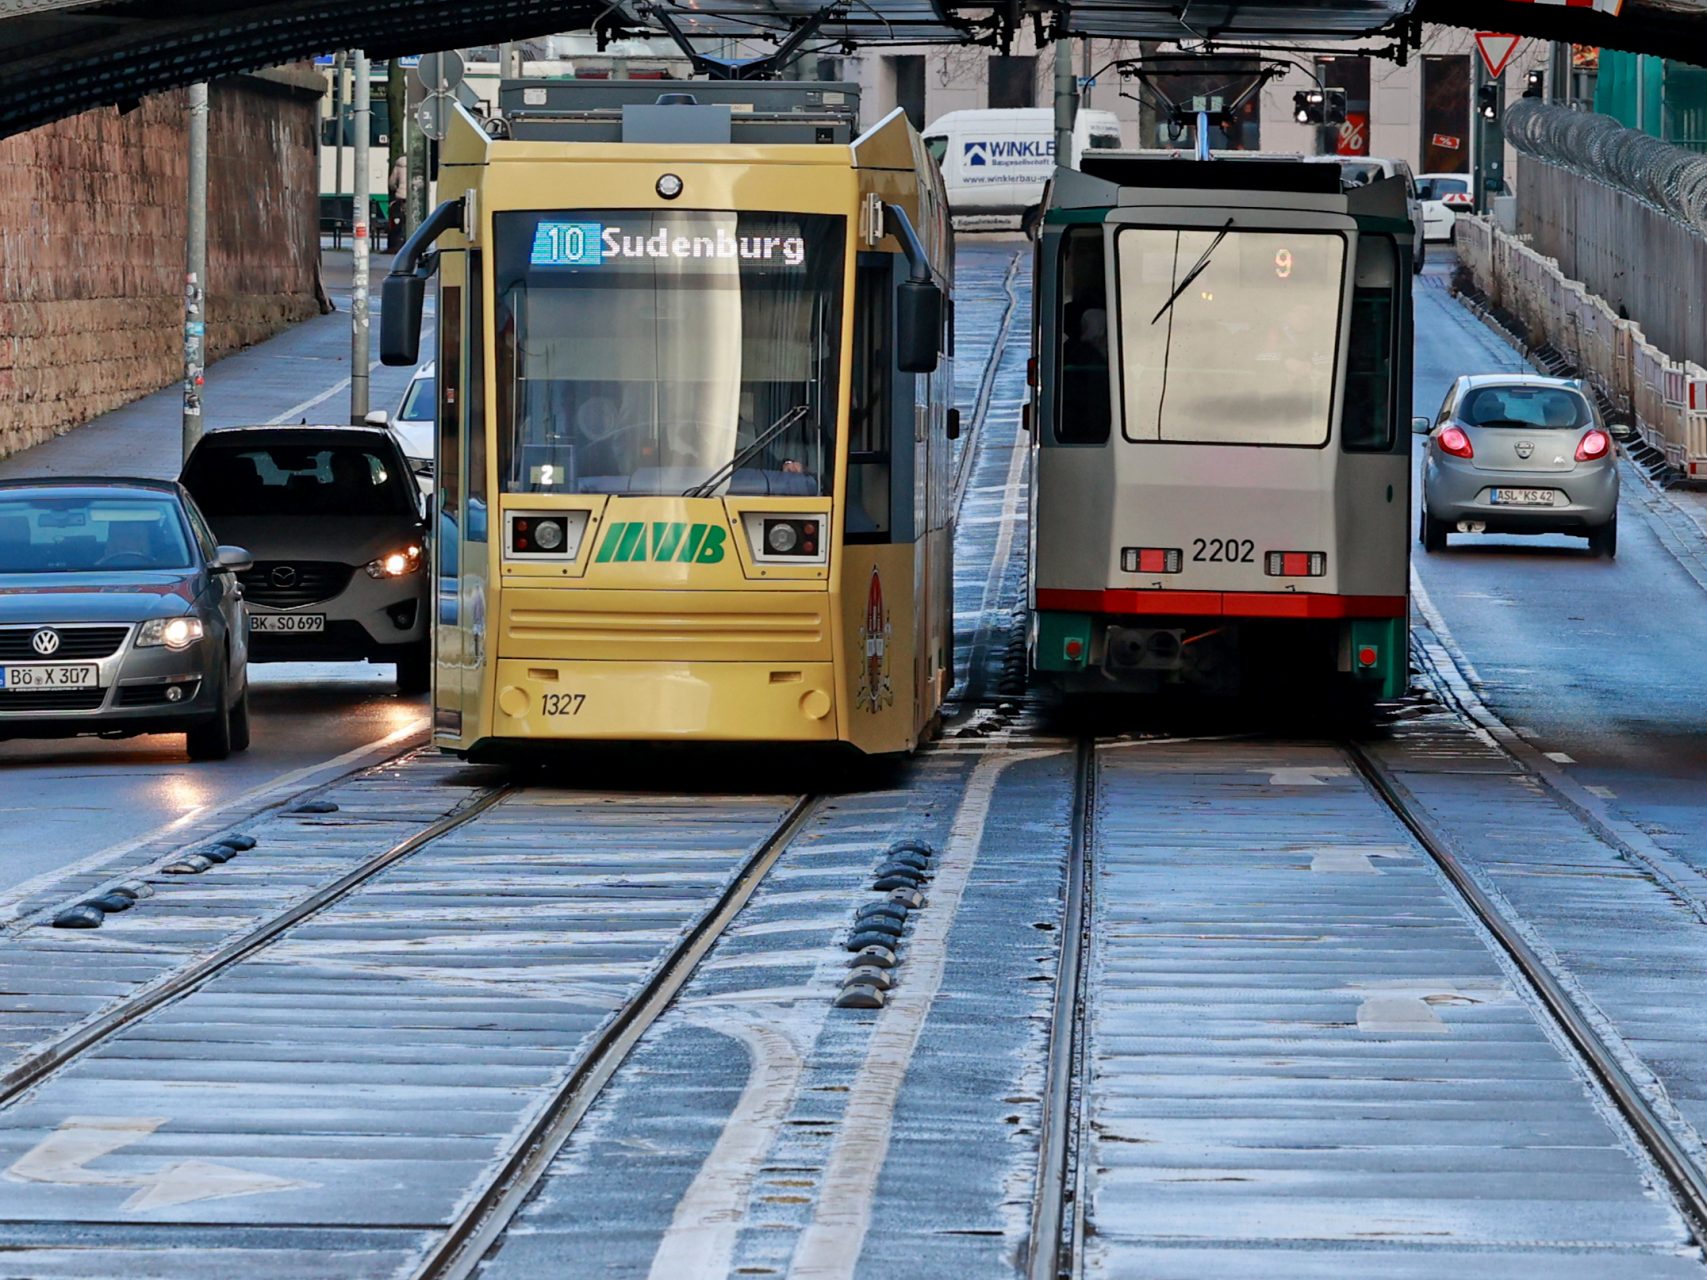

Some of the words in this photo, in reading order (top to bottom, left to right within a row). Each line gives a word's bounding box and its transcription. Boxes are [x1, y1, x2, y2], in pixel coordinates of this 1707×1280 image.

[548, 226, 585, 261] 10
[601, 227, 804, 265] Sudenburg
[1275, 248, 1293, 278] 9
[540, 464, 554, 485] 2
[1192, 538, 1255, 563] 2202
[251, 617, 268, 630] BK
[297, 617, 322, 630] 699
[59, 667, 90, 684] 307
[541, 693, 586, 716] 1327
